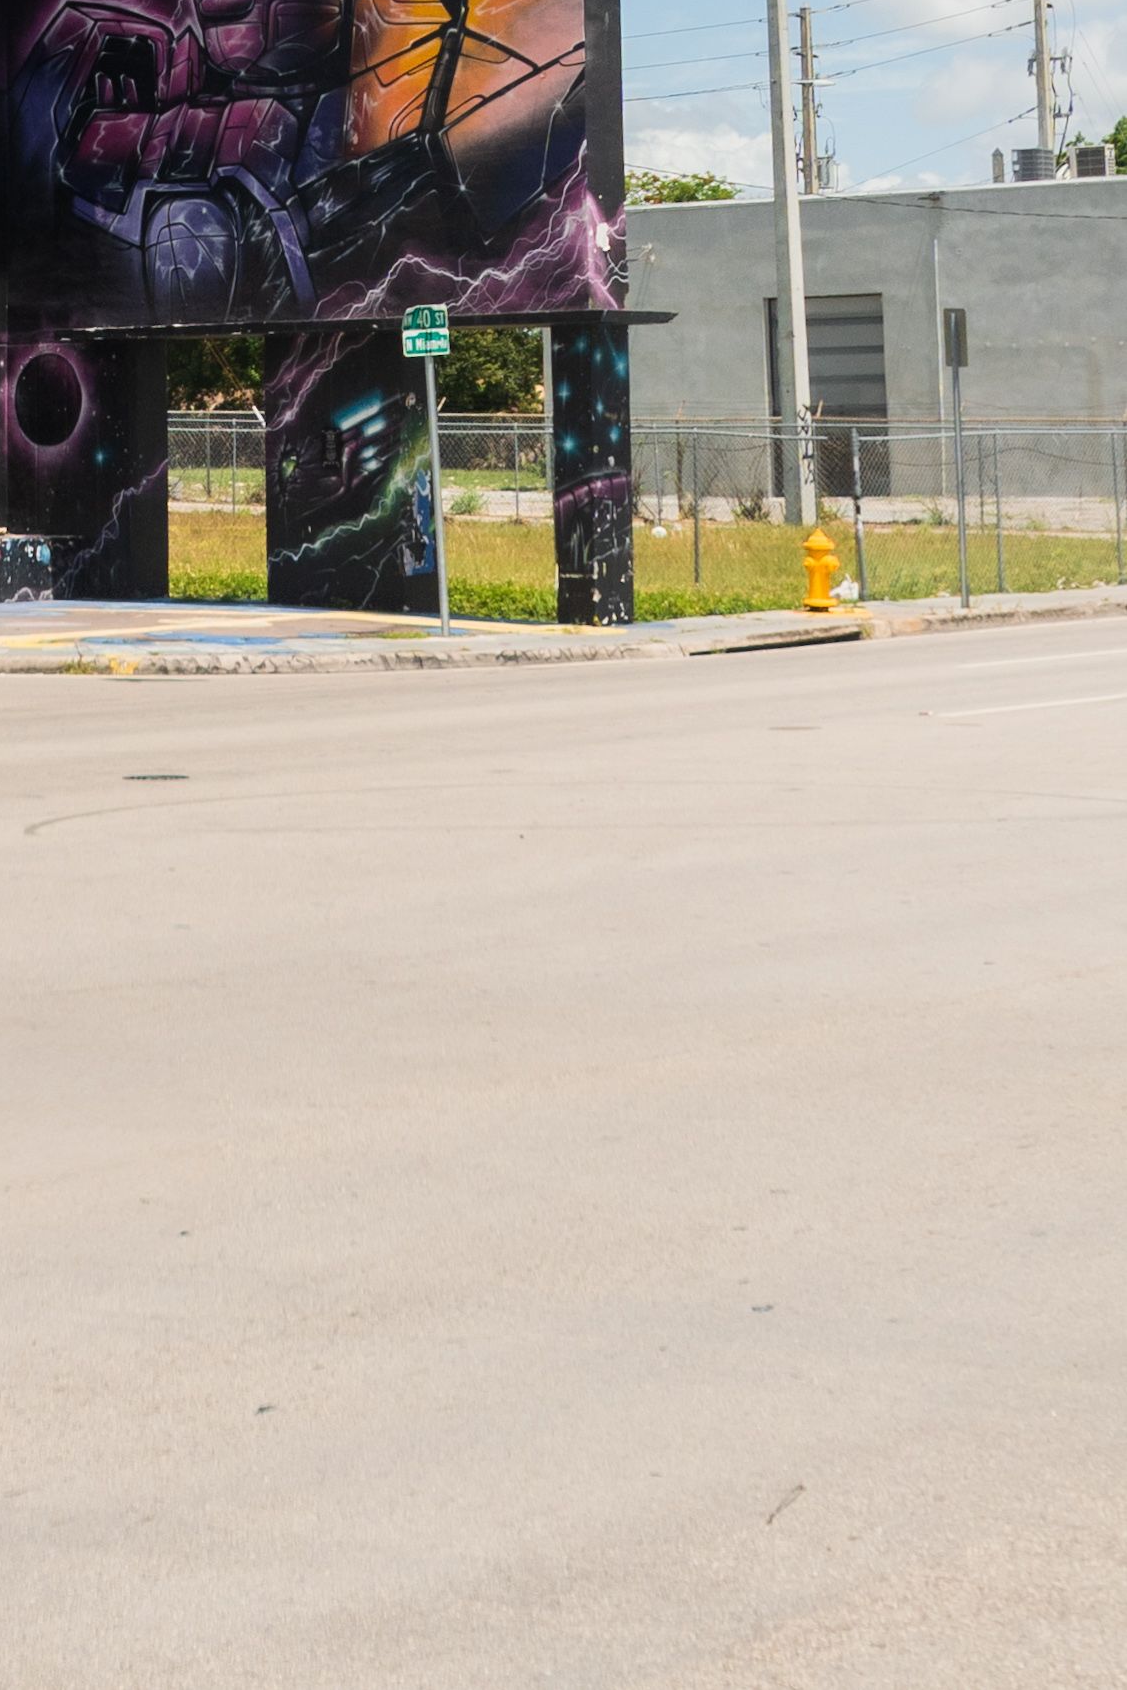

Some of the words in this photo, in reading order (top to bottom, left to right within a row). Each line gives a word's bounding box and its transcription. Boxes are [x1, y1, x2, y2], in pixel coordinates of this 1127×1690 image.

[417, 310, 431, 328] 40
[435, 312, 444, 326] ST
[406, 338, 413, 352] N
